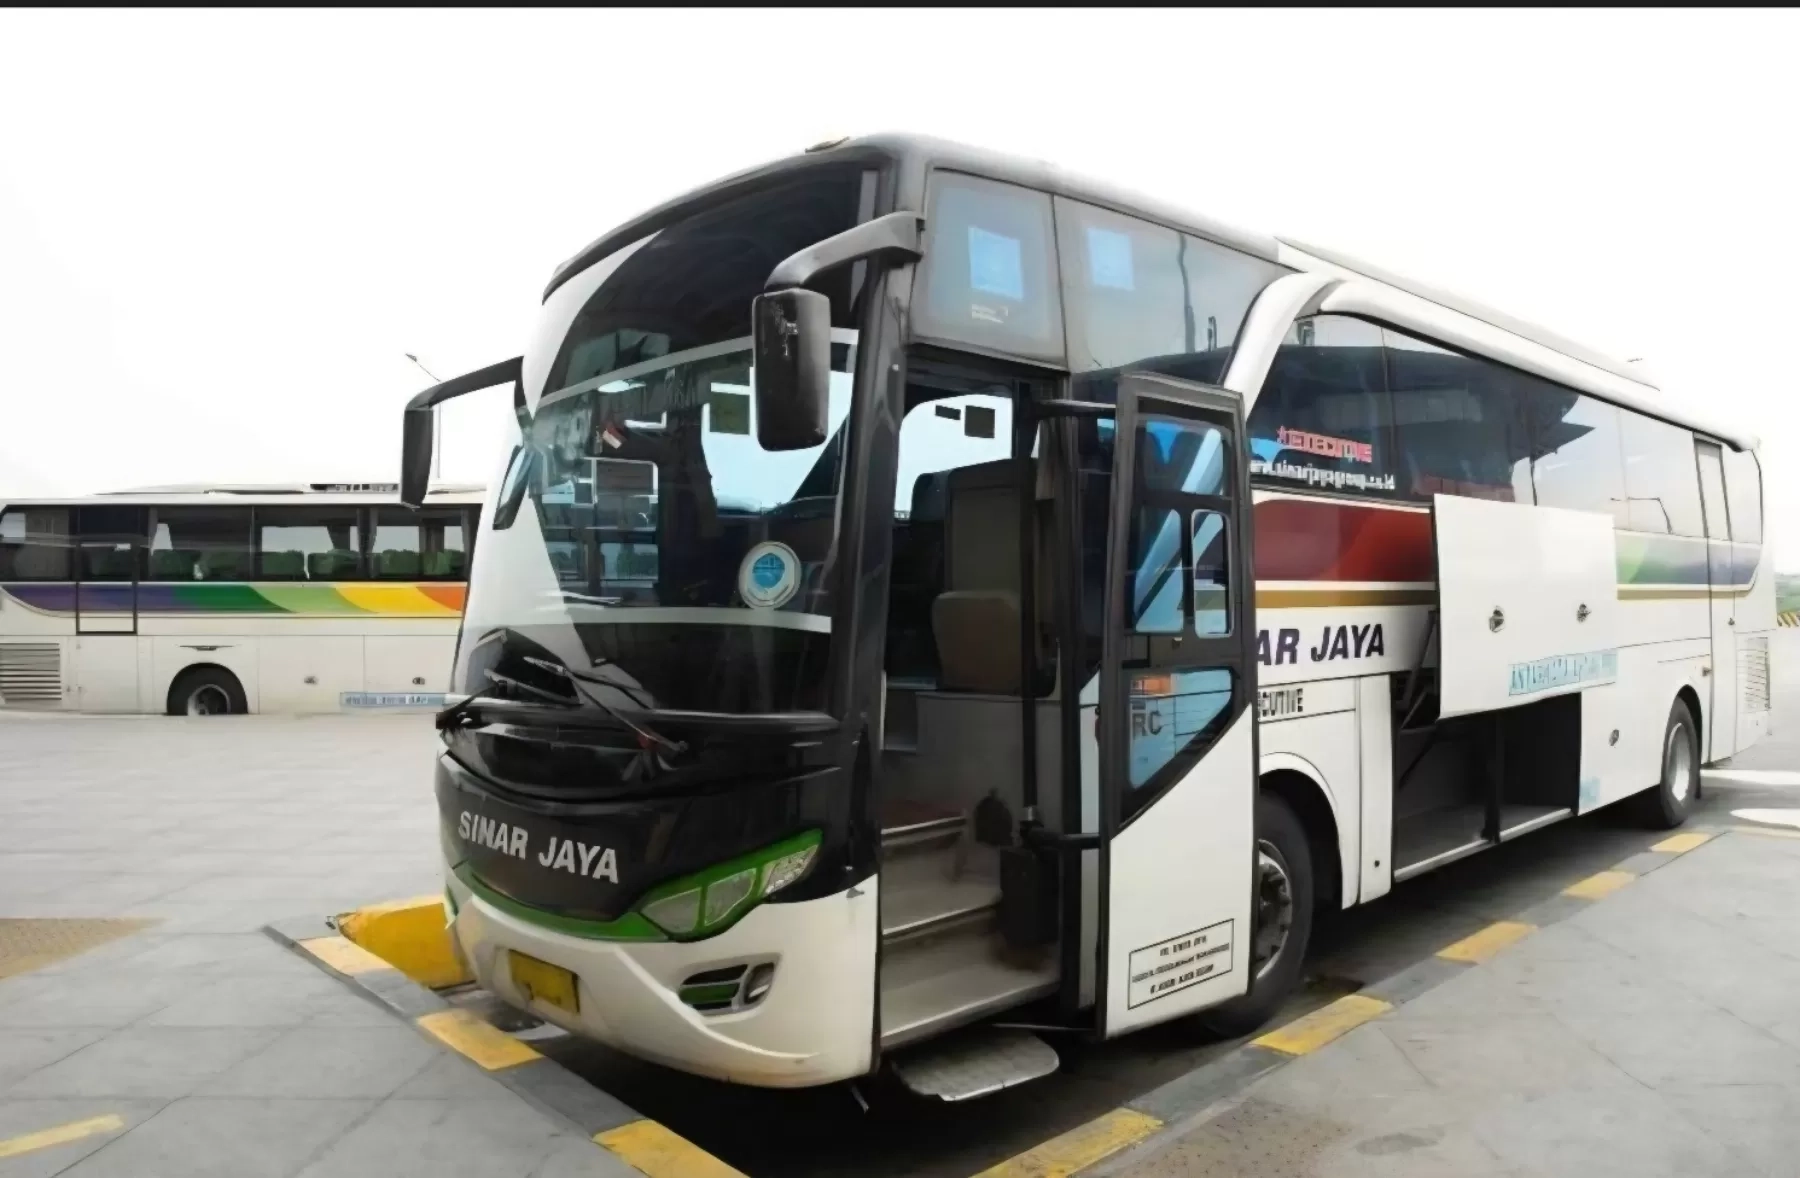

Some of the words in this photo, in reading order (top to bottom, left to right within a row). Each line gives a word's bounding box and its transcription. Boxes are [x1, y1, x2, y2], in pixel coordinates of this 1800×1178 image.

[1310, 623, 1384, 662] JAYA
[458, 810, 529, 860] SINAR
[538, 836, 619, 885] JAYA
